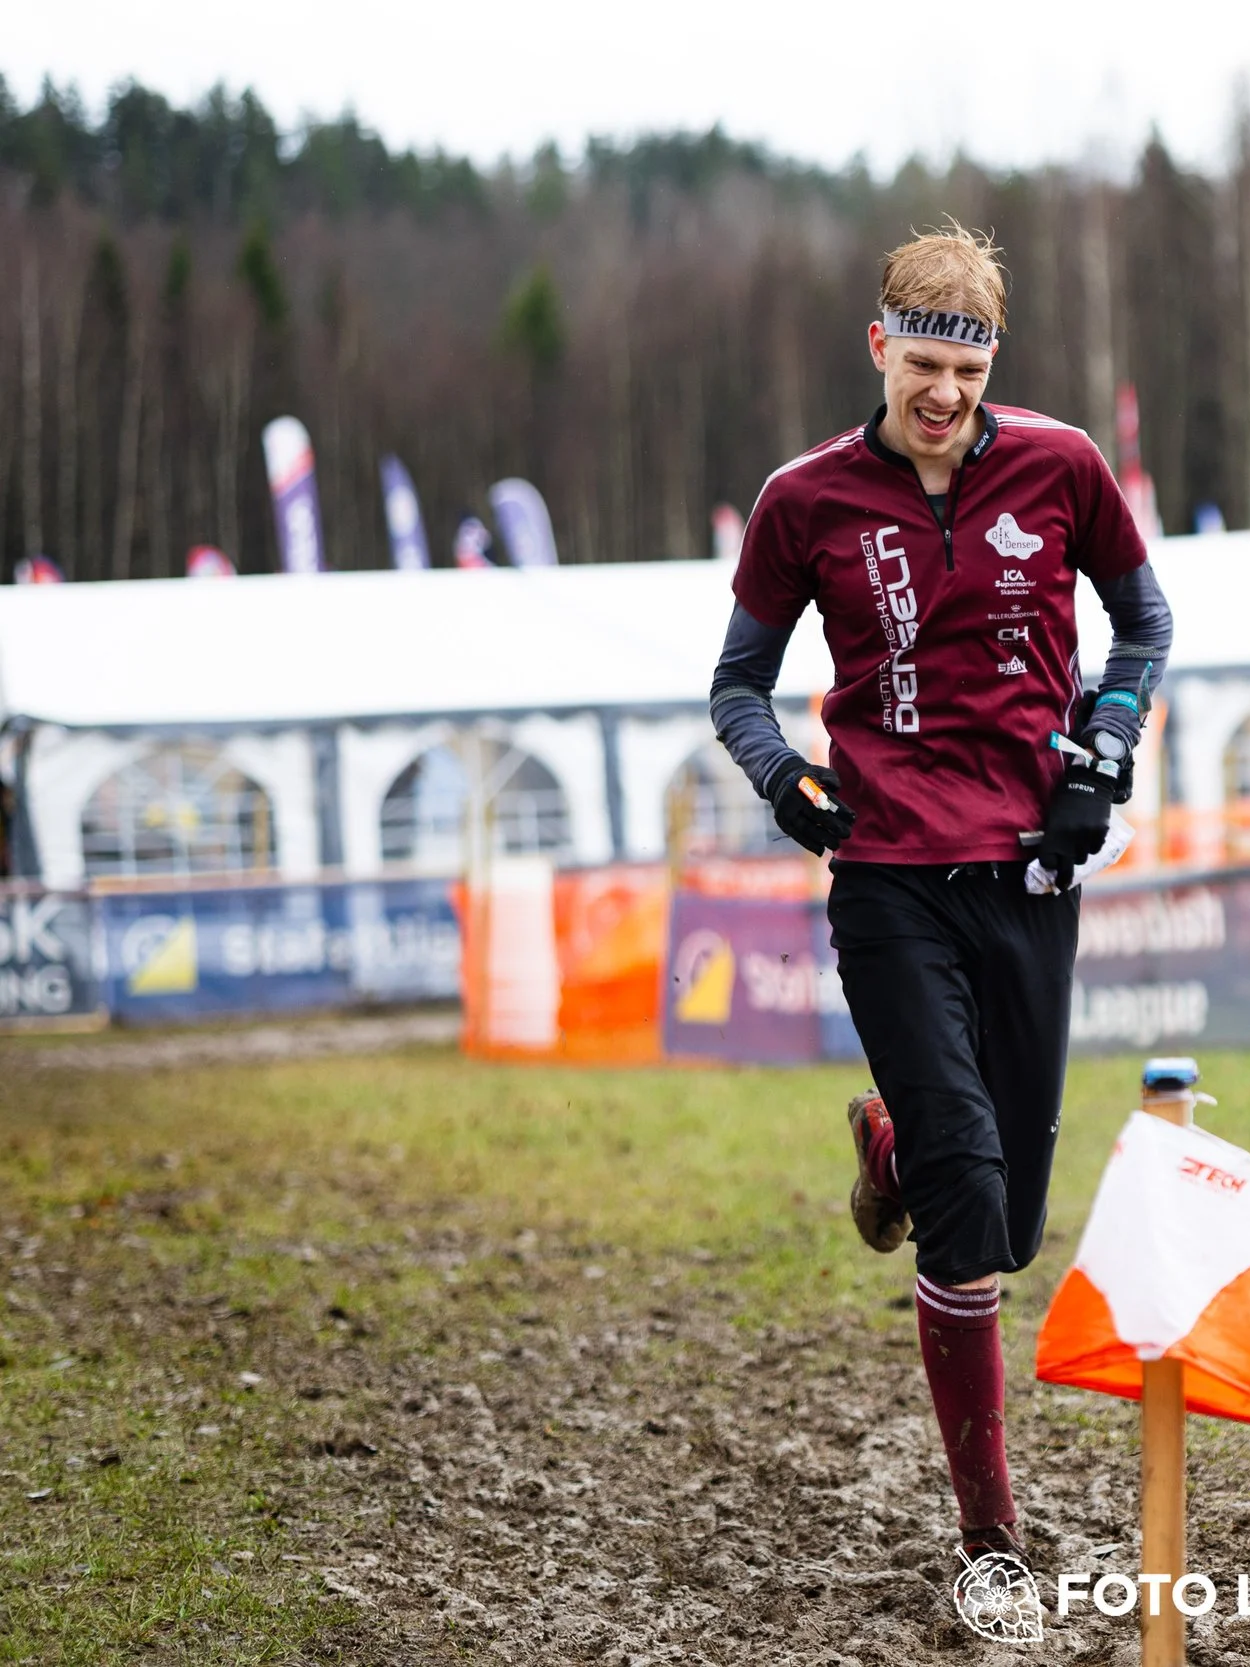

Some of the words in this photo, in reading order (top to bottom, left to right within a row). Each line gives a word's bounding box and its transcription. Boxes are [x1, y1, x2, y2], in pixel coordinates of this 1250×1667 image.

[1005, 540, 1039, 550] Denseln
[1003, 569, 1026, 581] ICA
[994, 580, 1037, 589] Supermarket
[875, 525, 920, 733] DENSELN
[997, 625, 1030, 641] CH
[1068, 783, 1096, 794] KIPRUN
